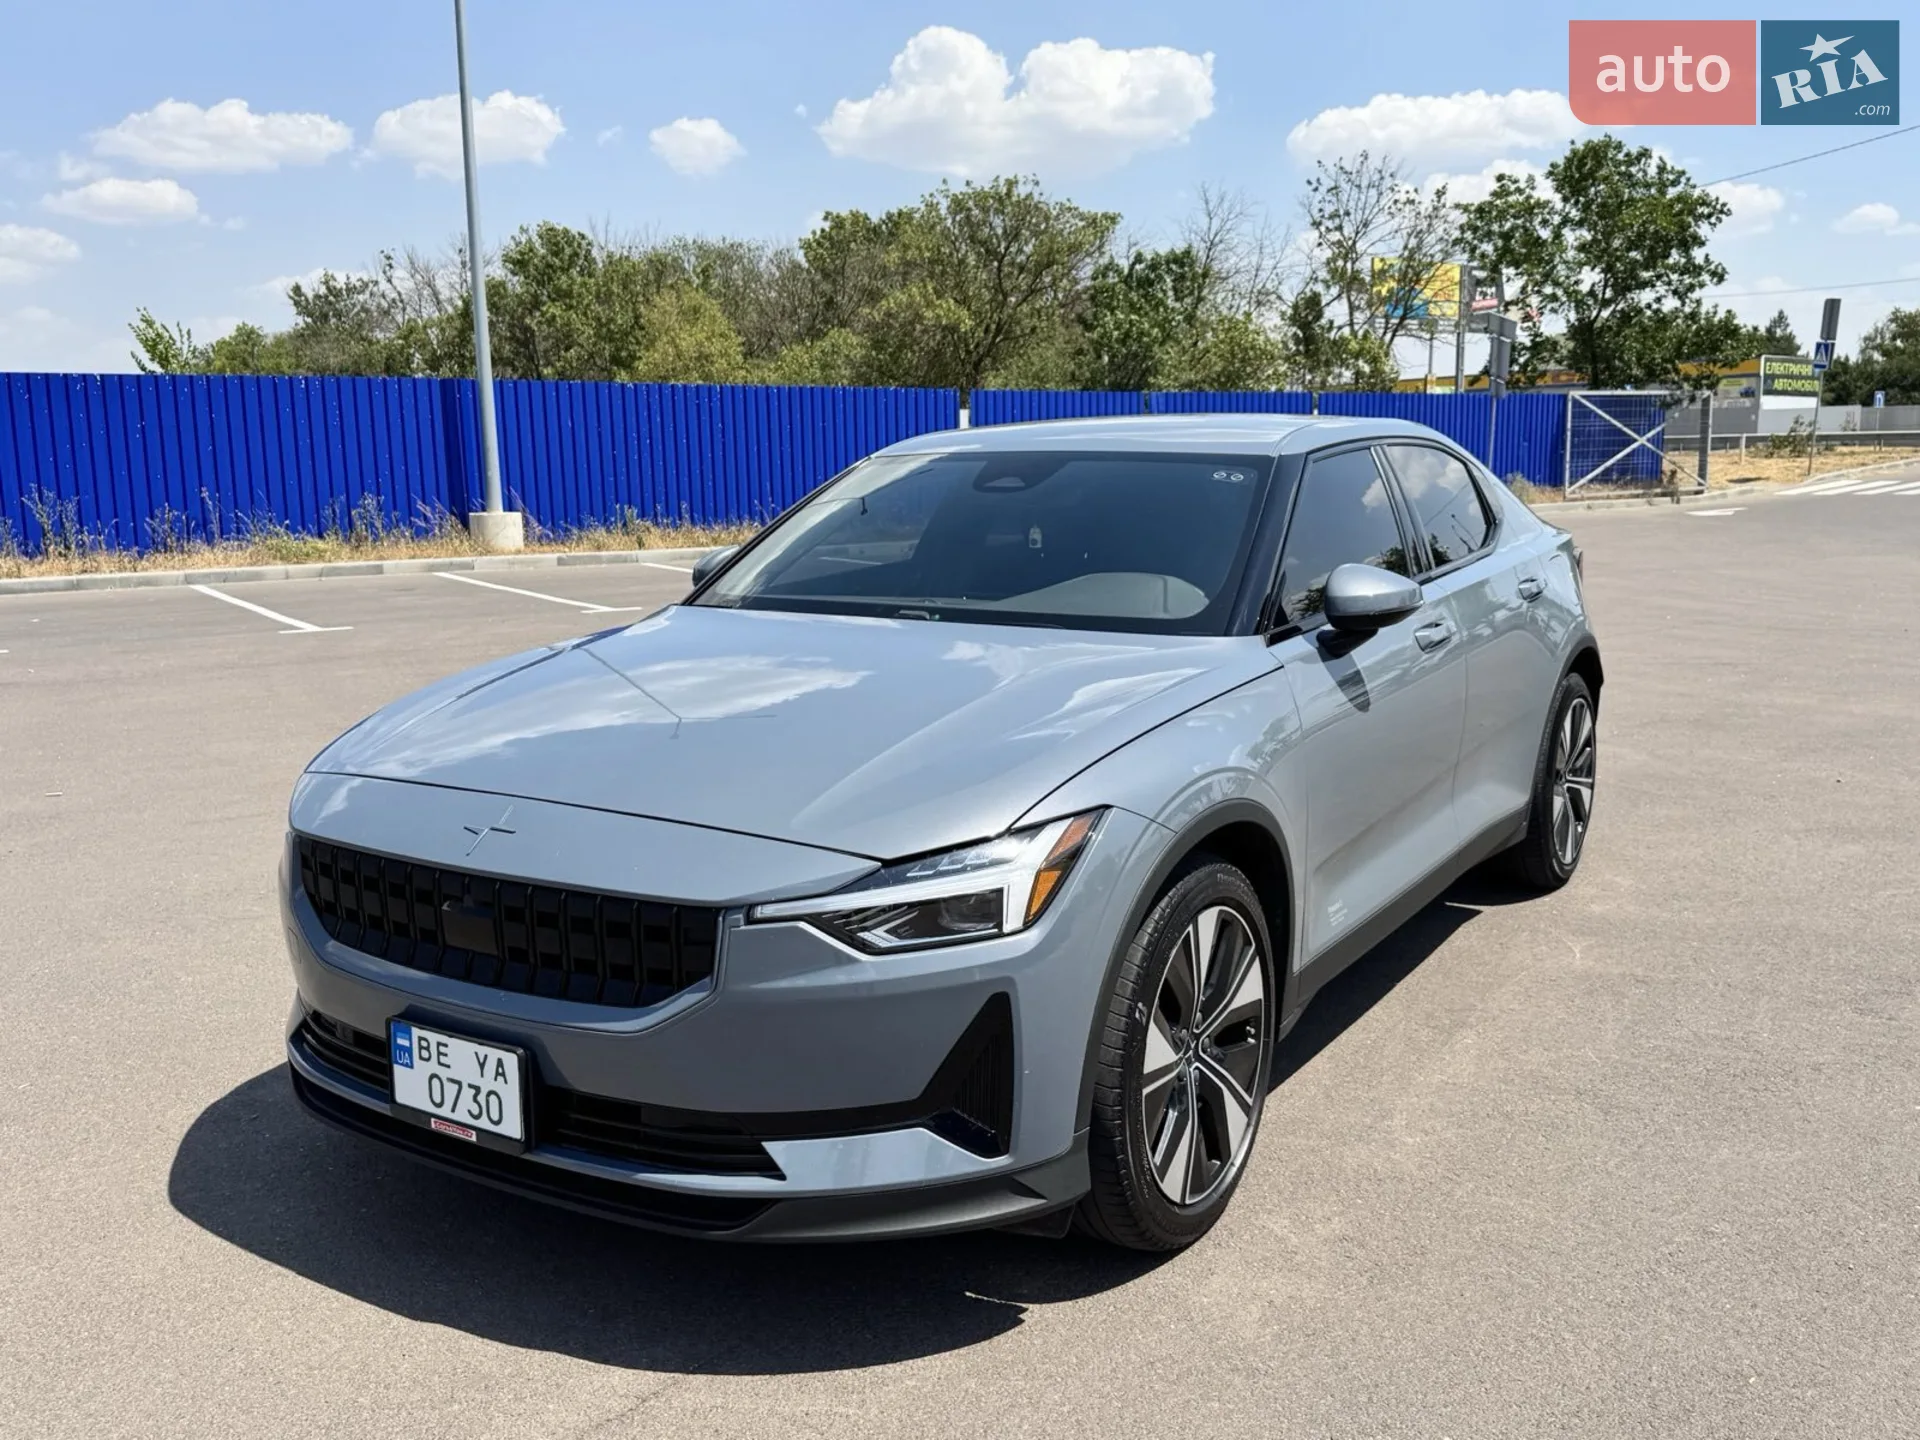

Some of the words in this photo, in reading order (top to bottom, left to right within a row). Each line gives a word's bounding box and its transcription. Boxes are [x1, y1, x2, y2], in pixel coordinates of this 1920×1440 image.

[396, 1050, 412, 1066] UA
[417, 1035, 451, 1069] BE
[474, 1051, 508, 1085] YA
[428, 1072, 503, 1126] 0730
